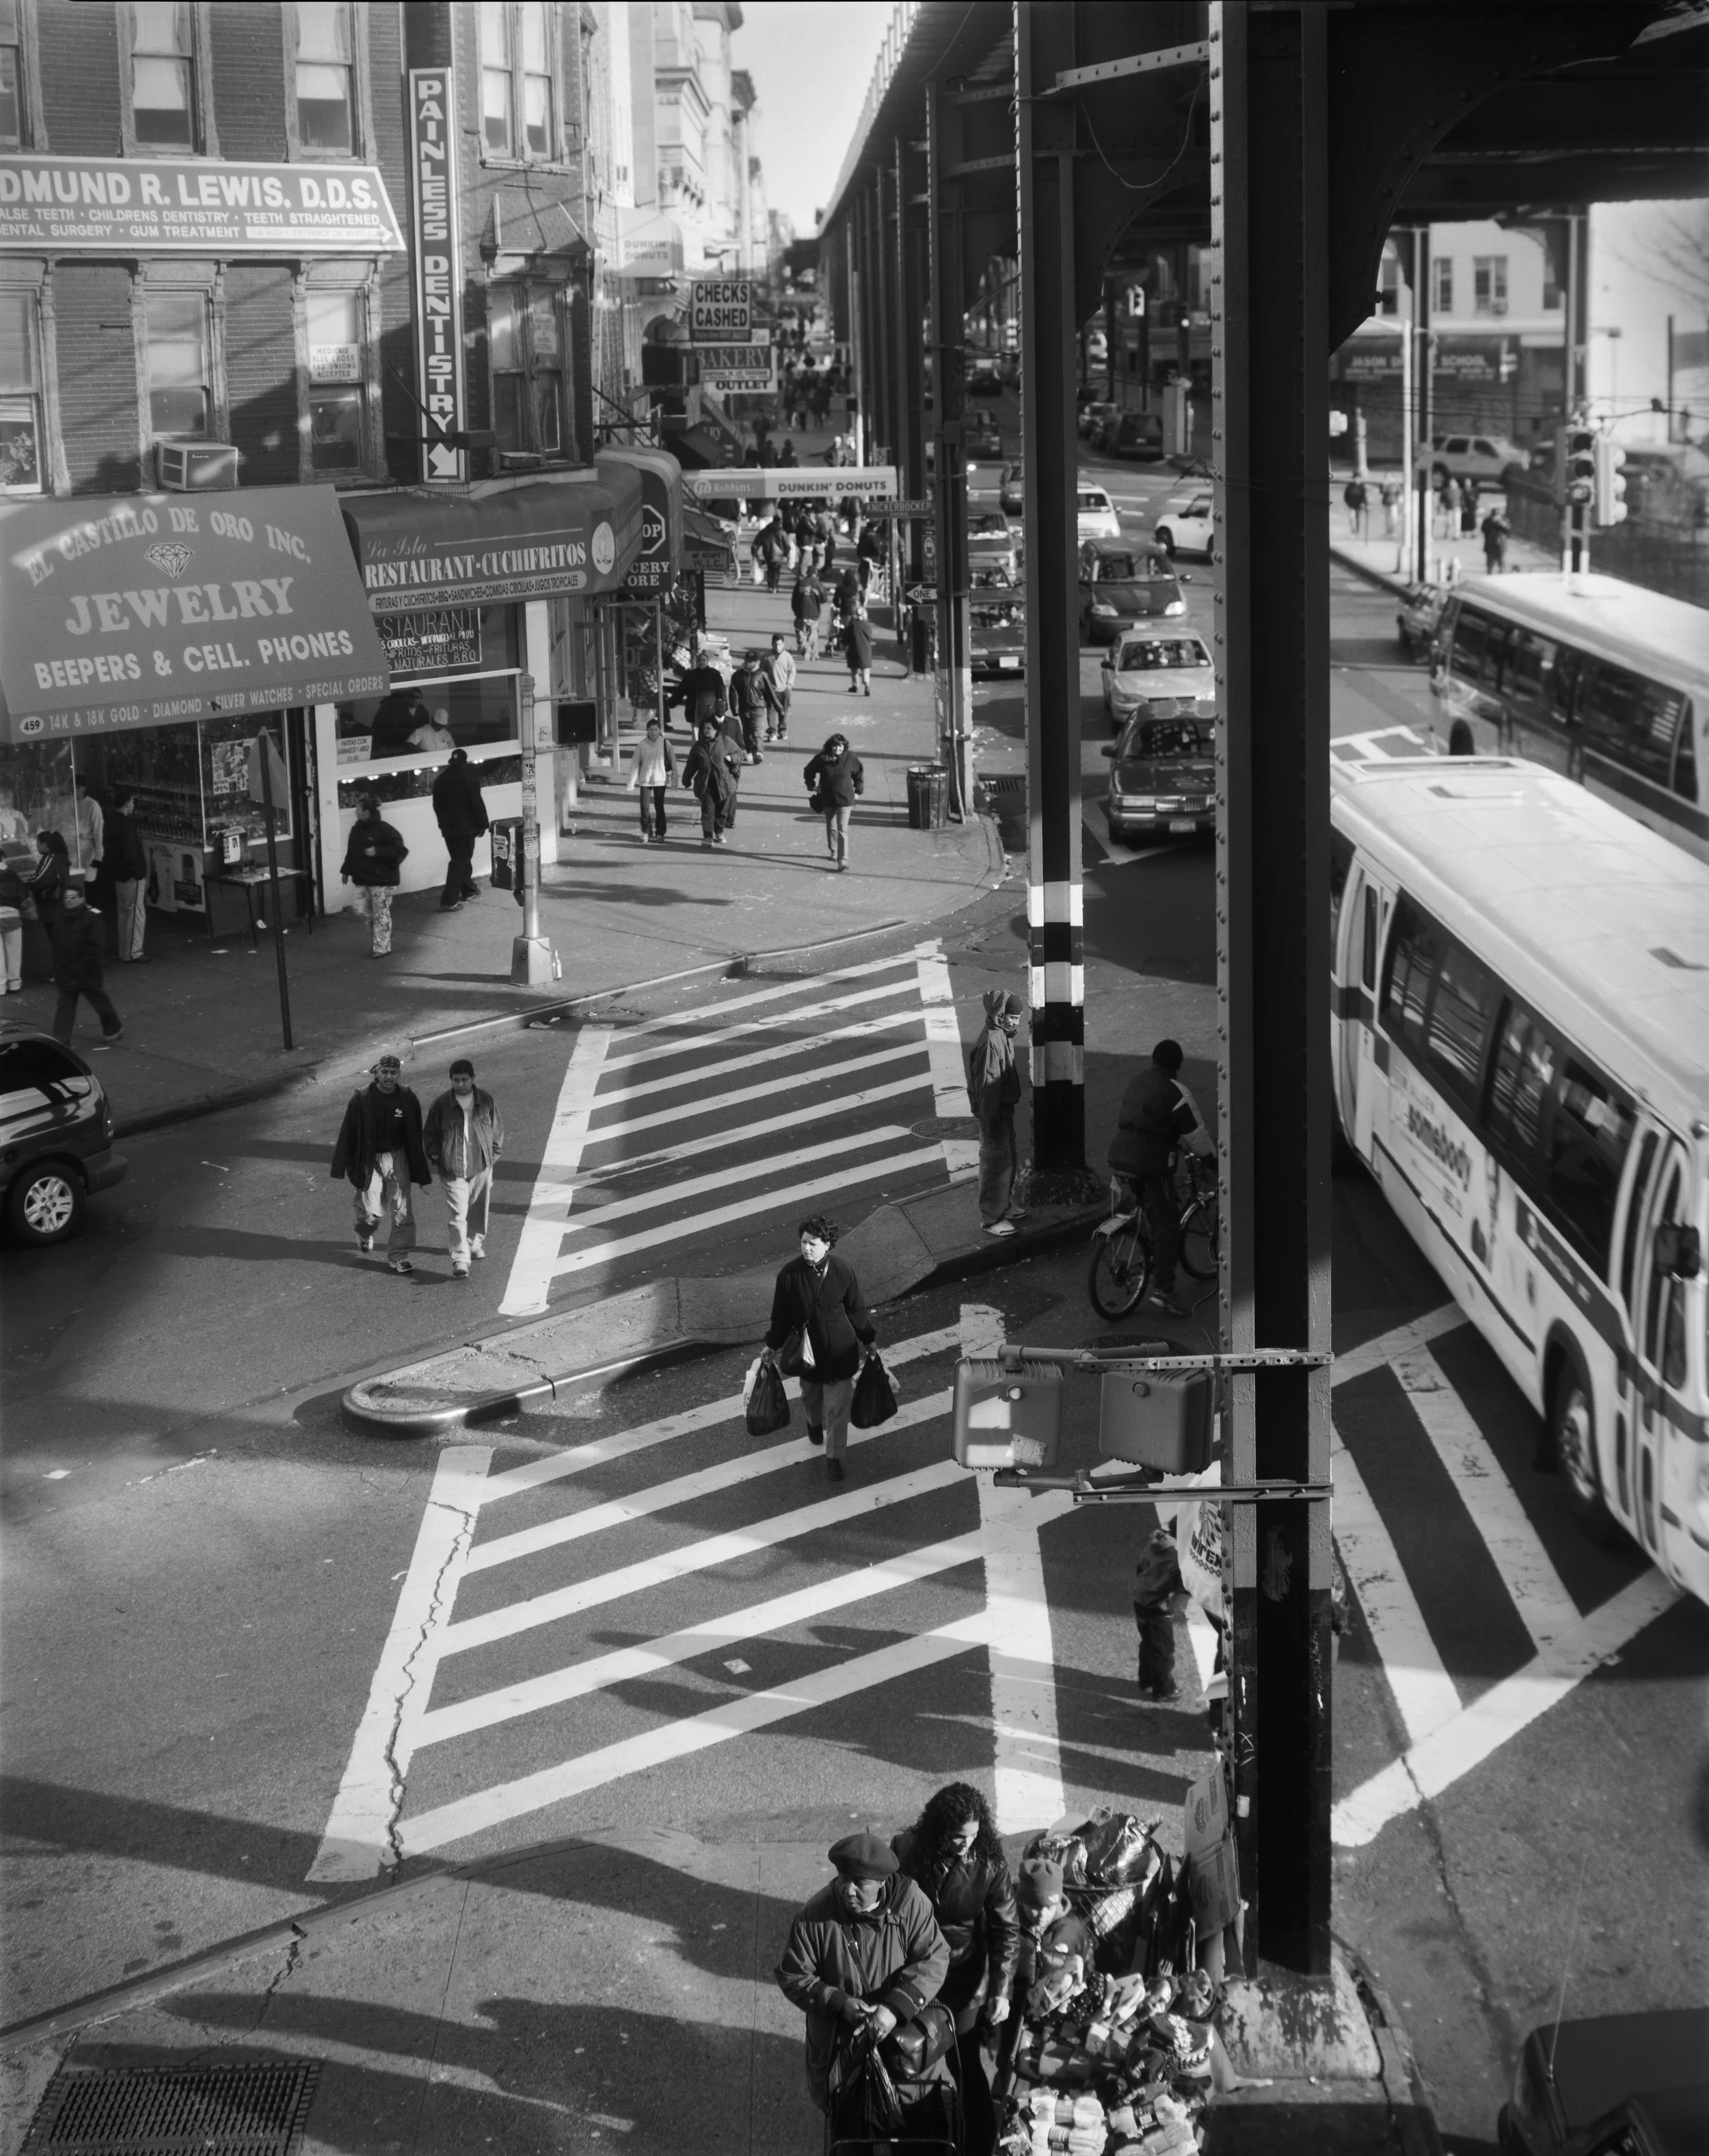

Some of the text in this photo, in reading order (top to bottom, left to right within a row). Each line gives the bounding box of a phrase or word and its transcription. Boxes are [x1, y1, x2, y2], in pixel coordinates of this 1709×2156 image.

[418, 80, 448, 240] PAINLESS
[139, 173, 171, 205] R.
[299, 177, 378, 209] D.D.S.
[34, 208, 75, 220] TEETH
[89, 209, 158, 222] CHILDRENS
[163, 211, 230, 223] DENTISTRY
[243, 212, 284, 224] TEETH
[289, 213, 380, 225] STRAIGHTENED
[0, 224, 44, 236] ENTAL
[50, 224, 112, 237] SURGERY
[130, 225, 159, 237] GUM
[163, 226, 241, 238] TREATMENT
[695, 283, 749, 303] CHECKS
[695, 307, 748, 327] CASHED
[424, 256, 455, 434] DENTISTRY
[329, 362, 356, 370] UNIONS
[697, 347, 768, 368] BAKERY
[317, 370, 351, 378] ACCEPTED
[716, 380, 768, 390] OUTLET
[835, 481, 887, 491] DONUTS
[866, 501, 932, 512] KNICKERBOCKER
[643, 524, 661, 537] OP
[24, 507, 312, 587] EL CASTILLO DE ORO INC.
[630, 561, 670, 573] CERY
[621, 574, 660, 587] ORE
[375, 596, 398, 610] FRITURAS
[551, 574, 578, 589] TROPICALES
[913, 589, 931, 598] ONE
[66, 576, 295, 635] JEWELRY
[376, 607, 474, 640] STAURANT
[34, 629, 354, 689] BEEPERS & CELL. PHONES
[394, 653, 449, 671] NATURALES
[49, 675, 383, 731] 14K & 18K GOLD DIAMOND SILVER WATCHES SPECIAL ORDERS
[24, 720, 40, 731] 459
